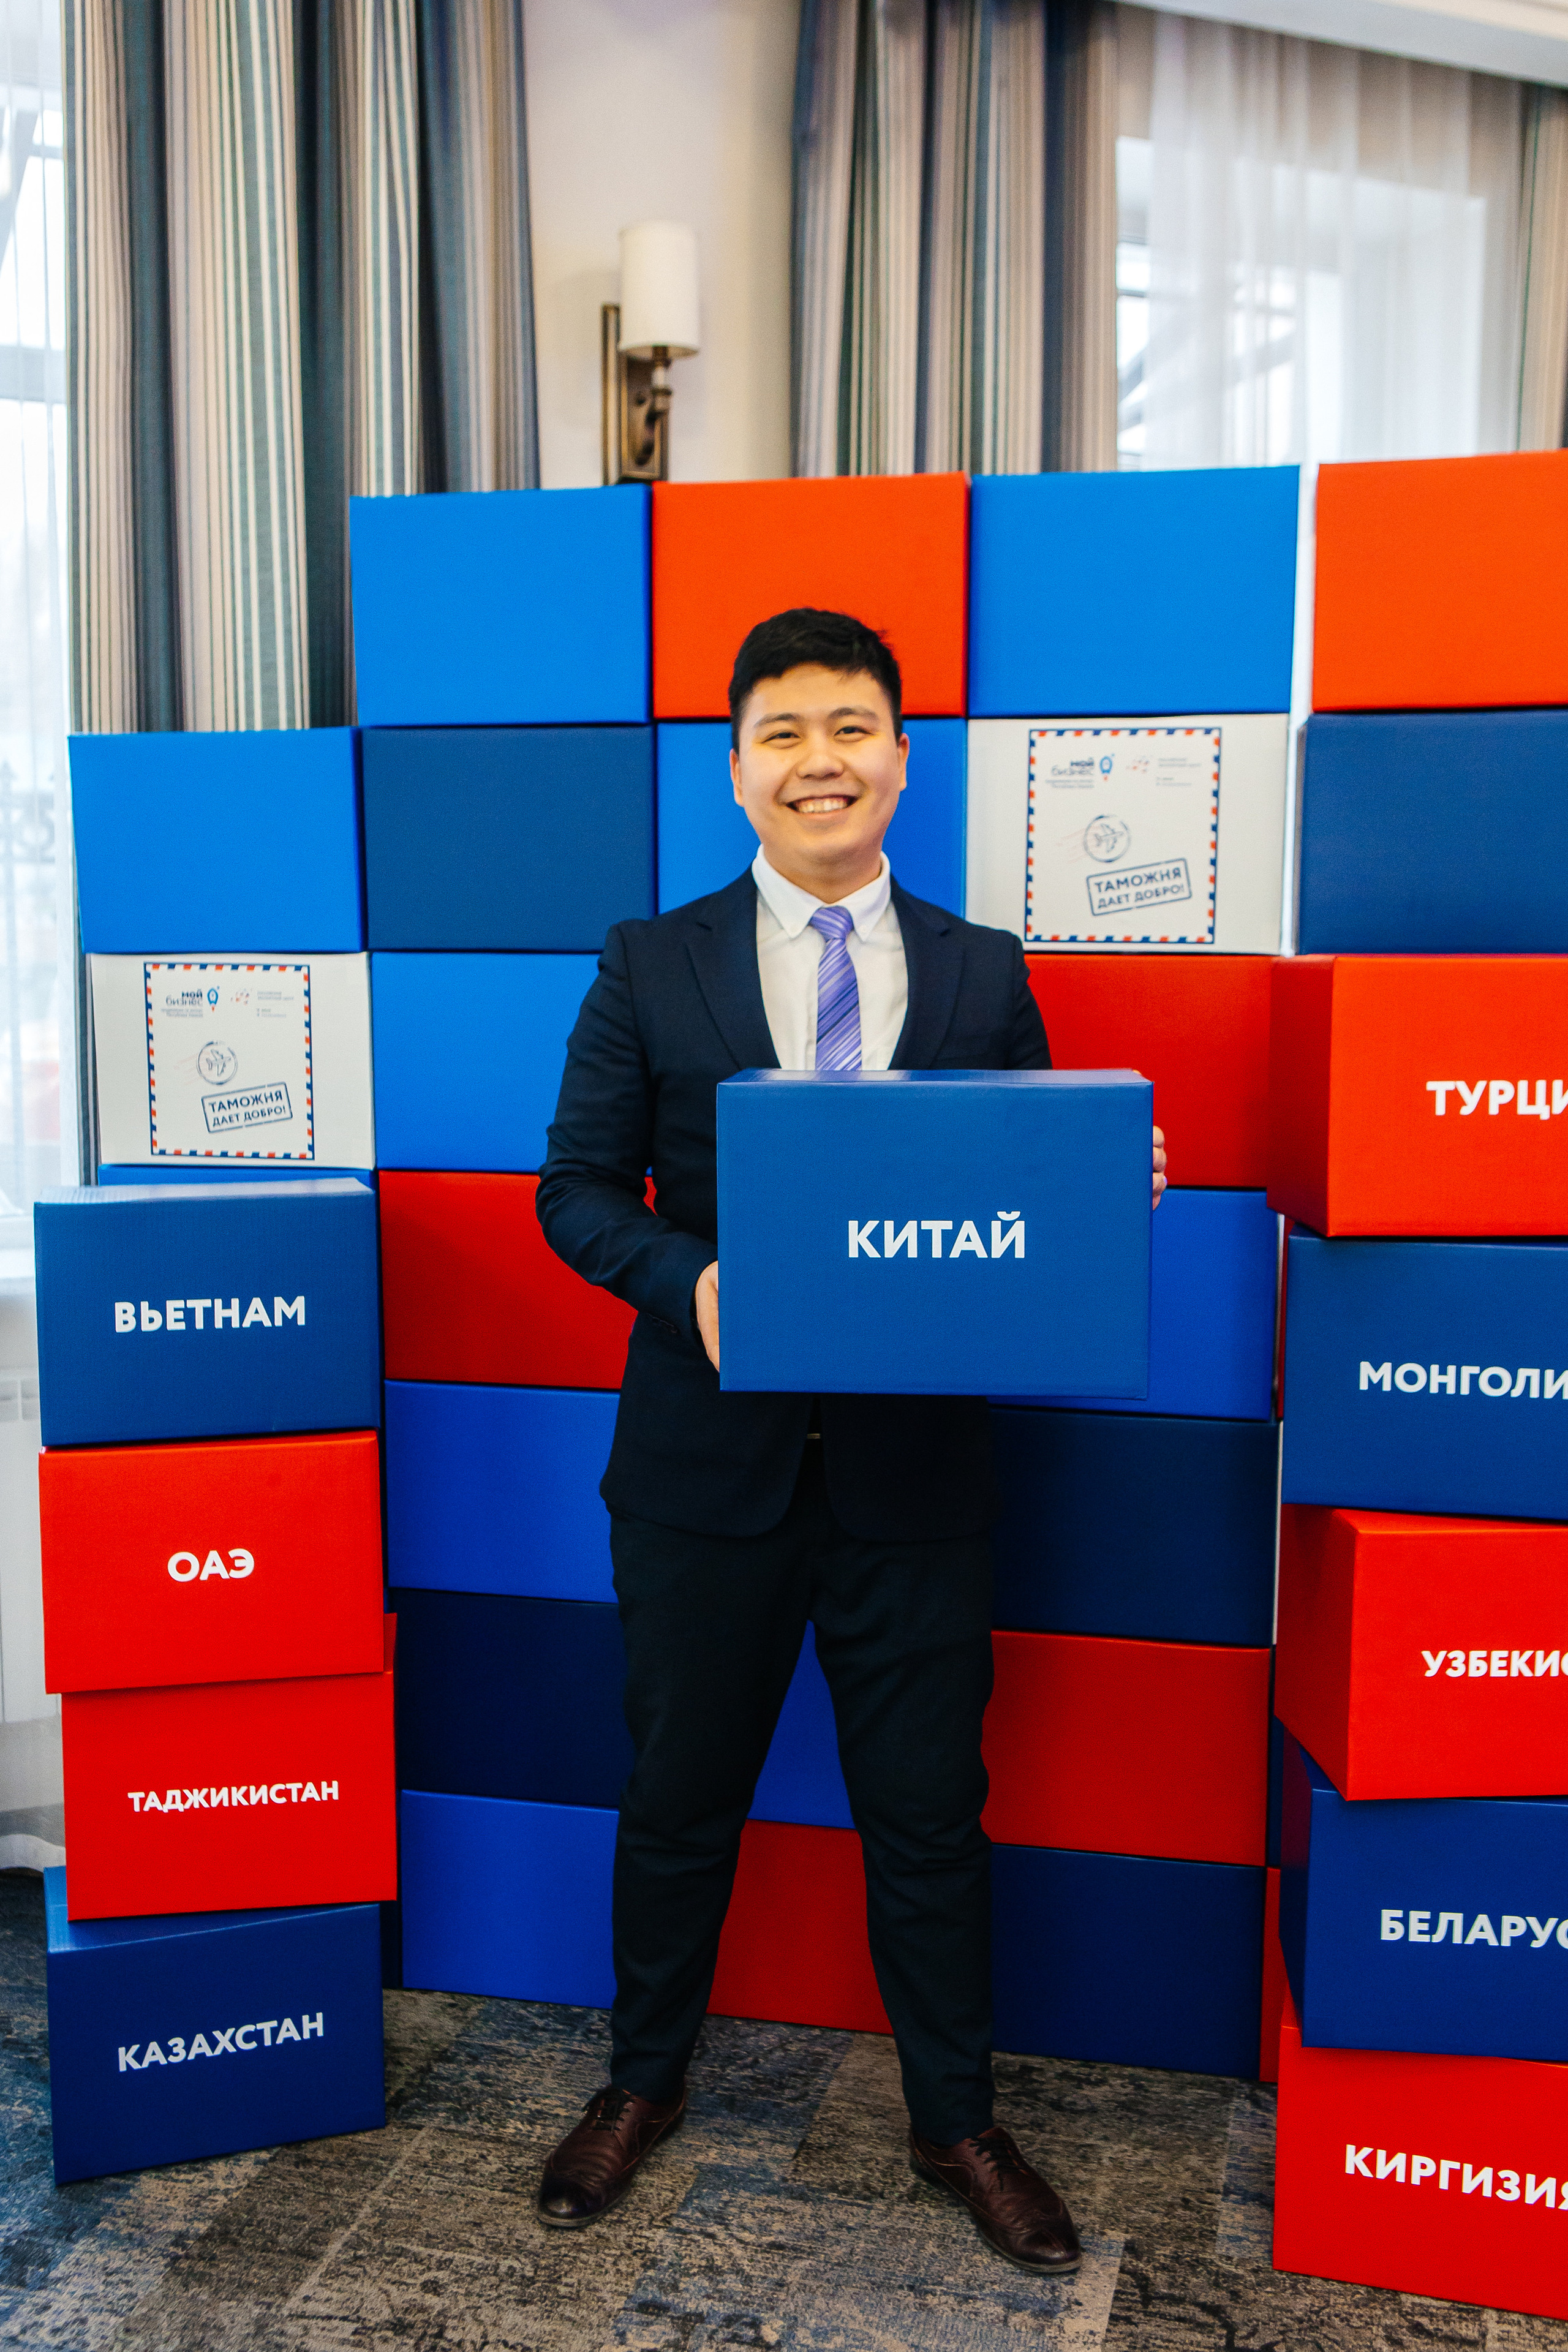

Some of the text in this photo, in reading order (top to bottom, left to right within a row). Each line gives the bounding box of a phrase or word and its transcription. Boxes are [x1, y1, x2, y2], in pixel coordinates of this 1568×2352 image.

[1094, 867, 1182, 893] ТАМОЖНЯ
[1098, 884, 1185, 909] ДАЕТ ДОБРО!
[208, 1090, 283, 1113] ТАМОЖНЯ
[213, 1105, 286, 1128] ДАЕТ ДОБРО!
[848, 1211, 1025, 1259] КИТАЙ
[115, 1295, 306, 1333] ВЬЕТНАМ
[1359, 1361, 1568, 1400] МОНГОЛИ
[167, 1548, 255, 1582] ОАЭ
[1421, 1650, 1568, 1677] УЗБЕКИ
[127, 1781, 339, 1812] ТАДЖИКИСТАН
[118, 2012, 324, 2071] КАЗАХСТАН
